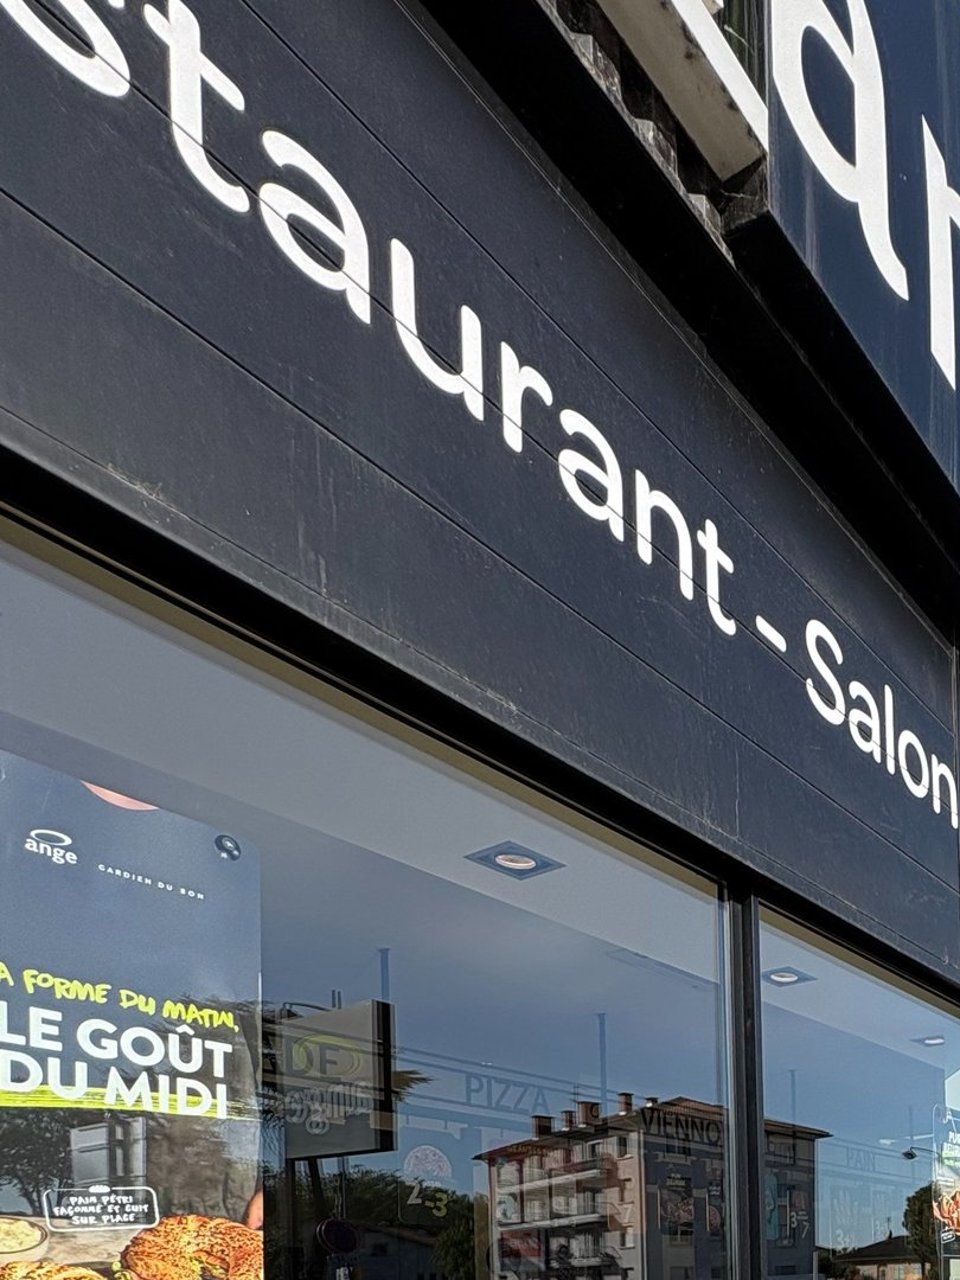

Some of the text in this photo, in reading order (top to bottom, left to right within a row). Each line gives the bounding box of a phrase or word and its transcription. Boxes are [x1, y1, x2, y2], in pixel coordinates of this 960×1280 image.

[806, 619, 959, 829] Salon
[25, 838, 78, 864] ange
[98, 864, 204, 899] GARDIEN DU BON
[23, 969, 112, 1003] FORME
[119, 989, 156, 1015] DU
[163, 1000, 239, 1032] MATIN,
[0, 1000, 233, 1078] LE GOÛT
[0, 1049, 88, 1099] DU
[104, 1066, 227, 1119] MIDI
[465, 1074, 550, 1114] PIZZA
[69, 1195, 98, 1205] PAIN
[107, 1204, 120, 1213] ET
[72, 1215, 97, 1225] SUR
